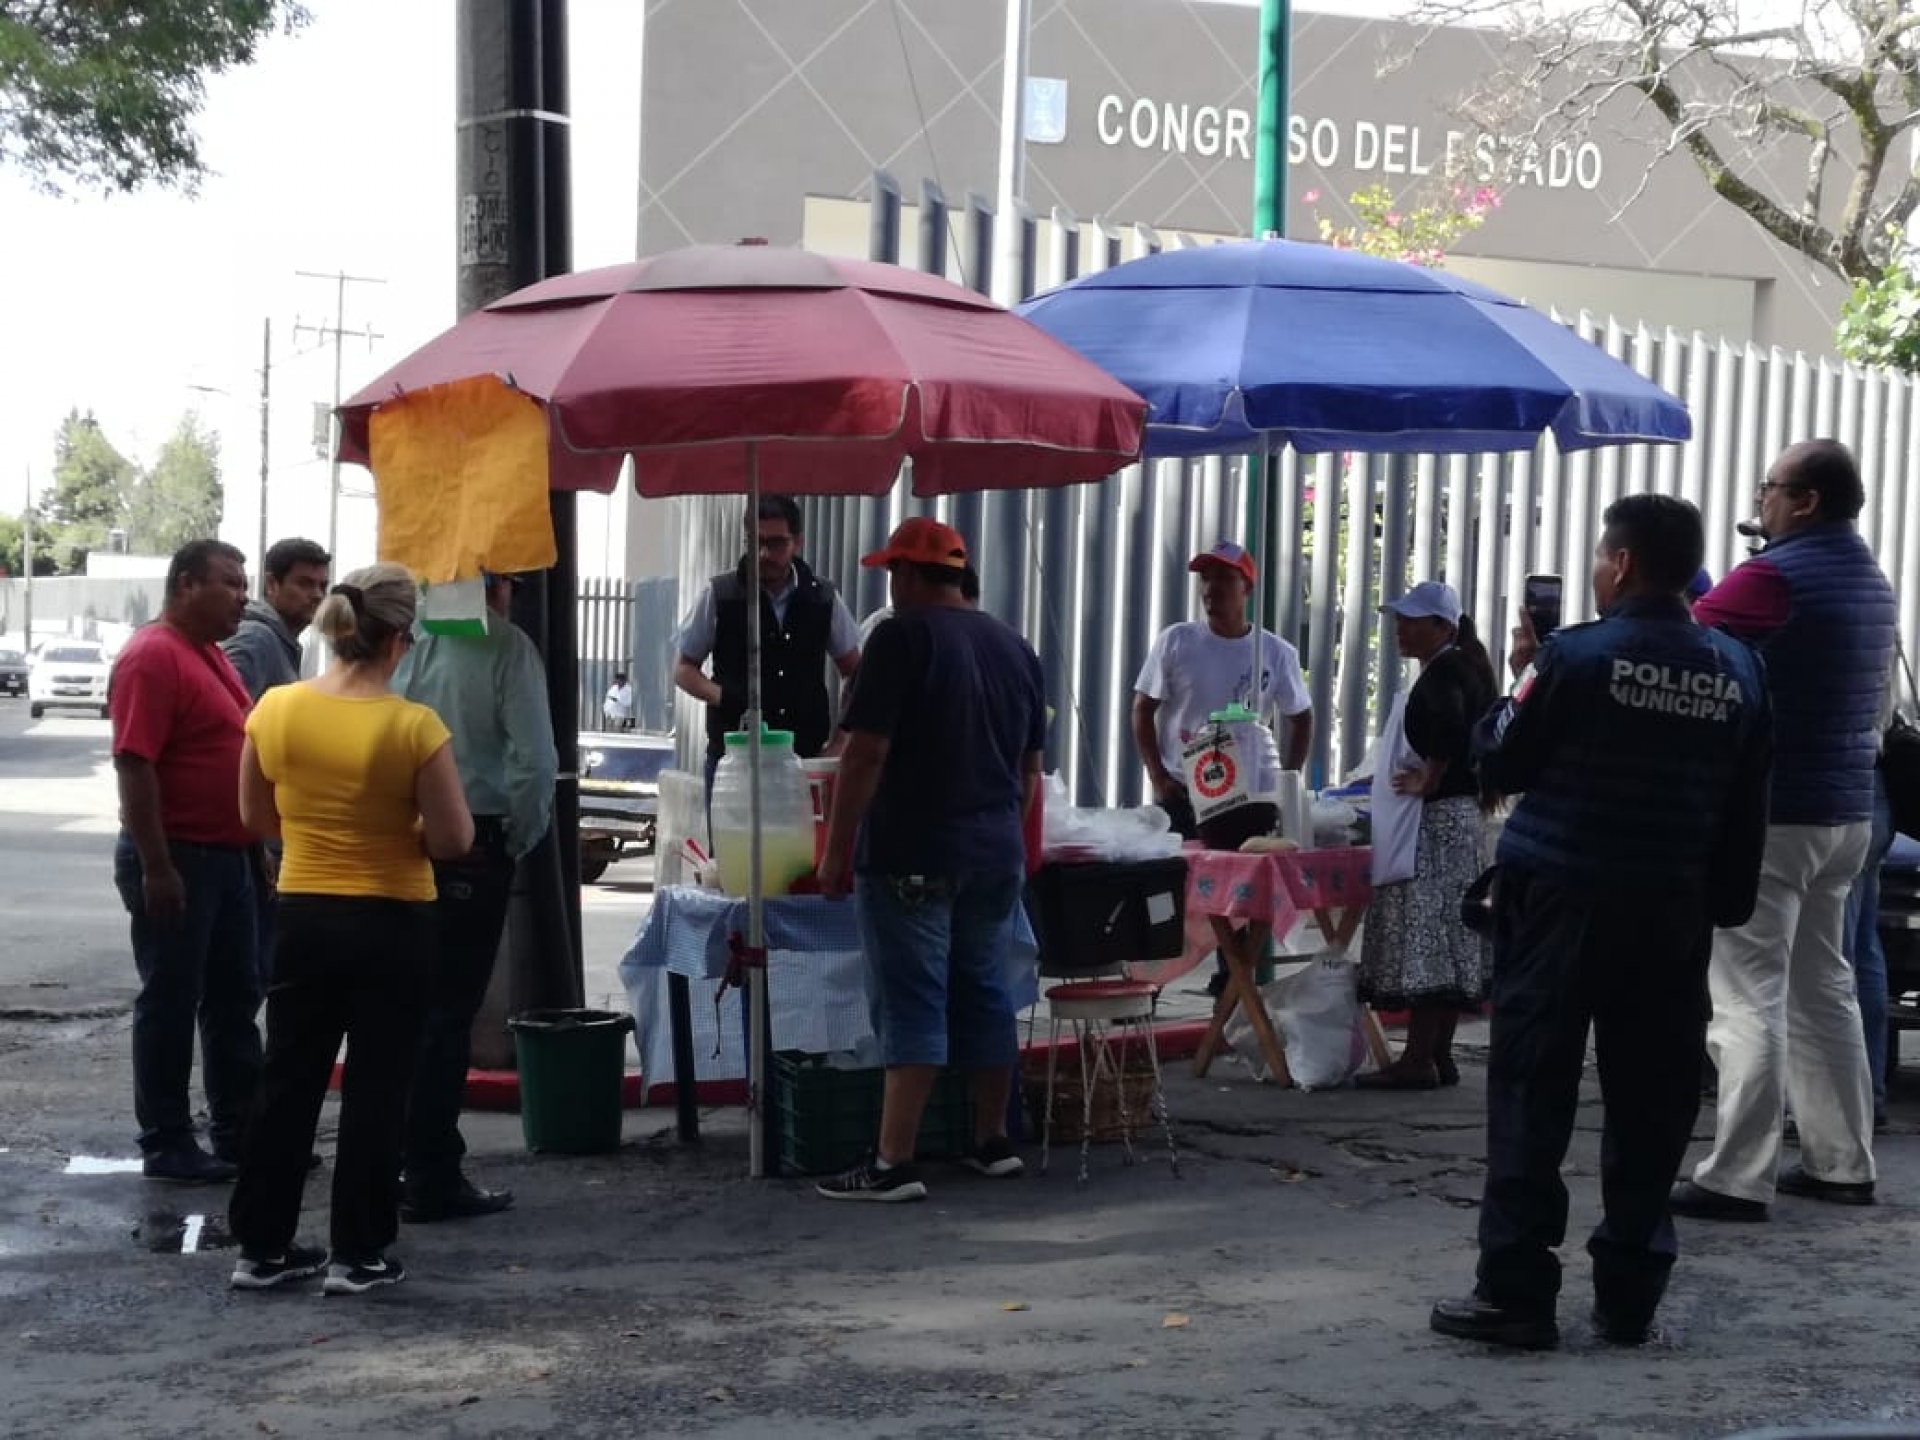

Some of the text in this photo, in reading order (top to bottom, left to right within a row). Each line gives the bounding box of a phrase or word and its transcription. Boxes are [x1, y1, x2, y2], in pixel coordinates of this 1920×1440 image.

[1098, 94, 1339, 167] CONGRSO
[1354, 121, 1430, 174] DEL
[1611, 658, 1744, 704] POLICÍA
